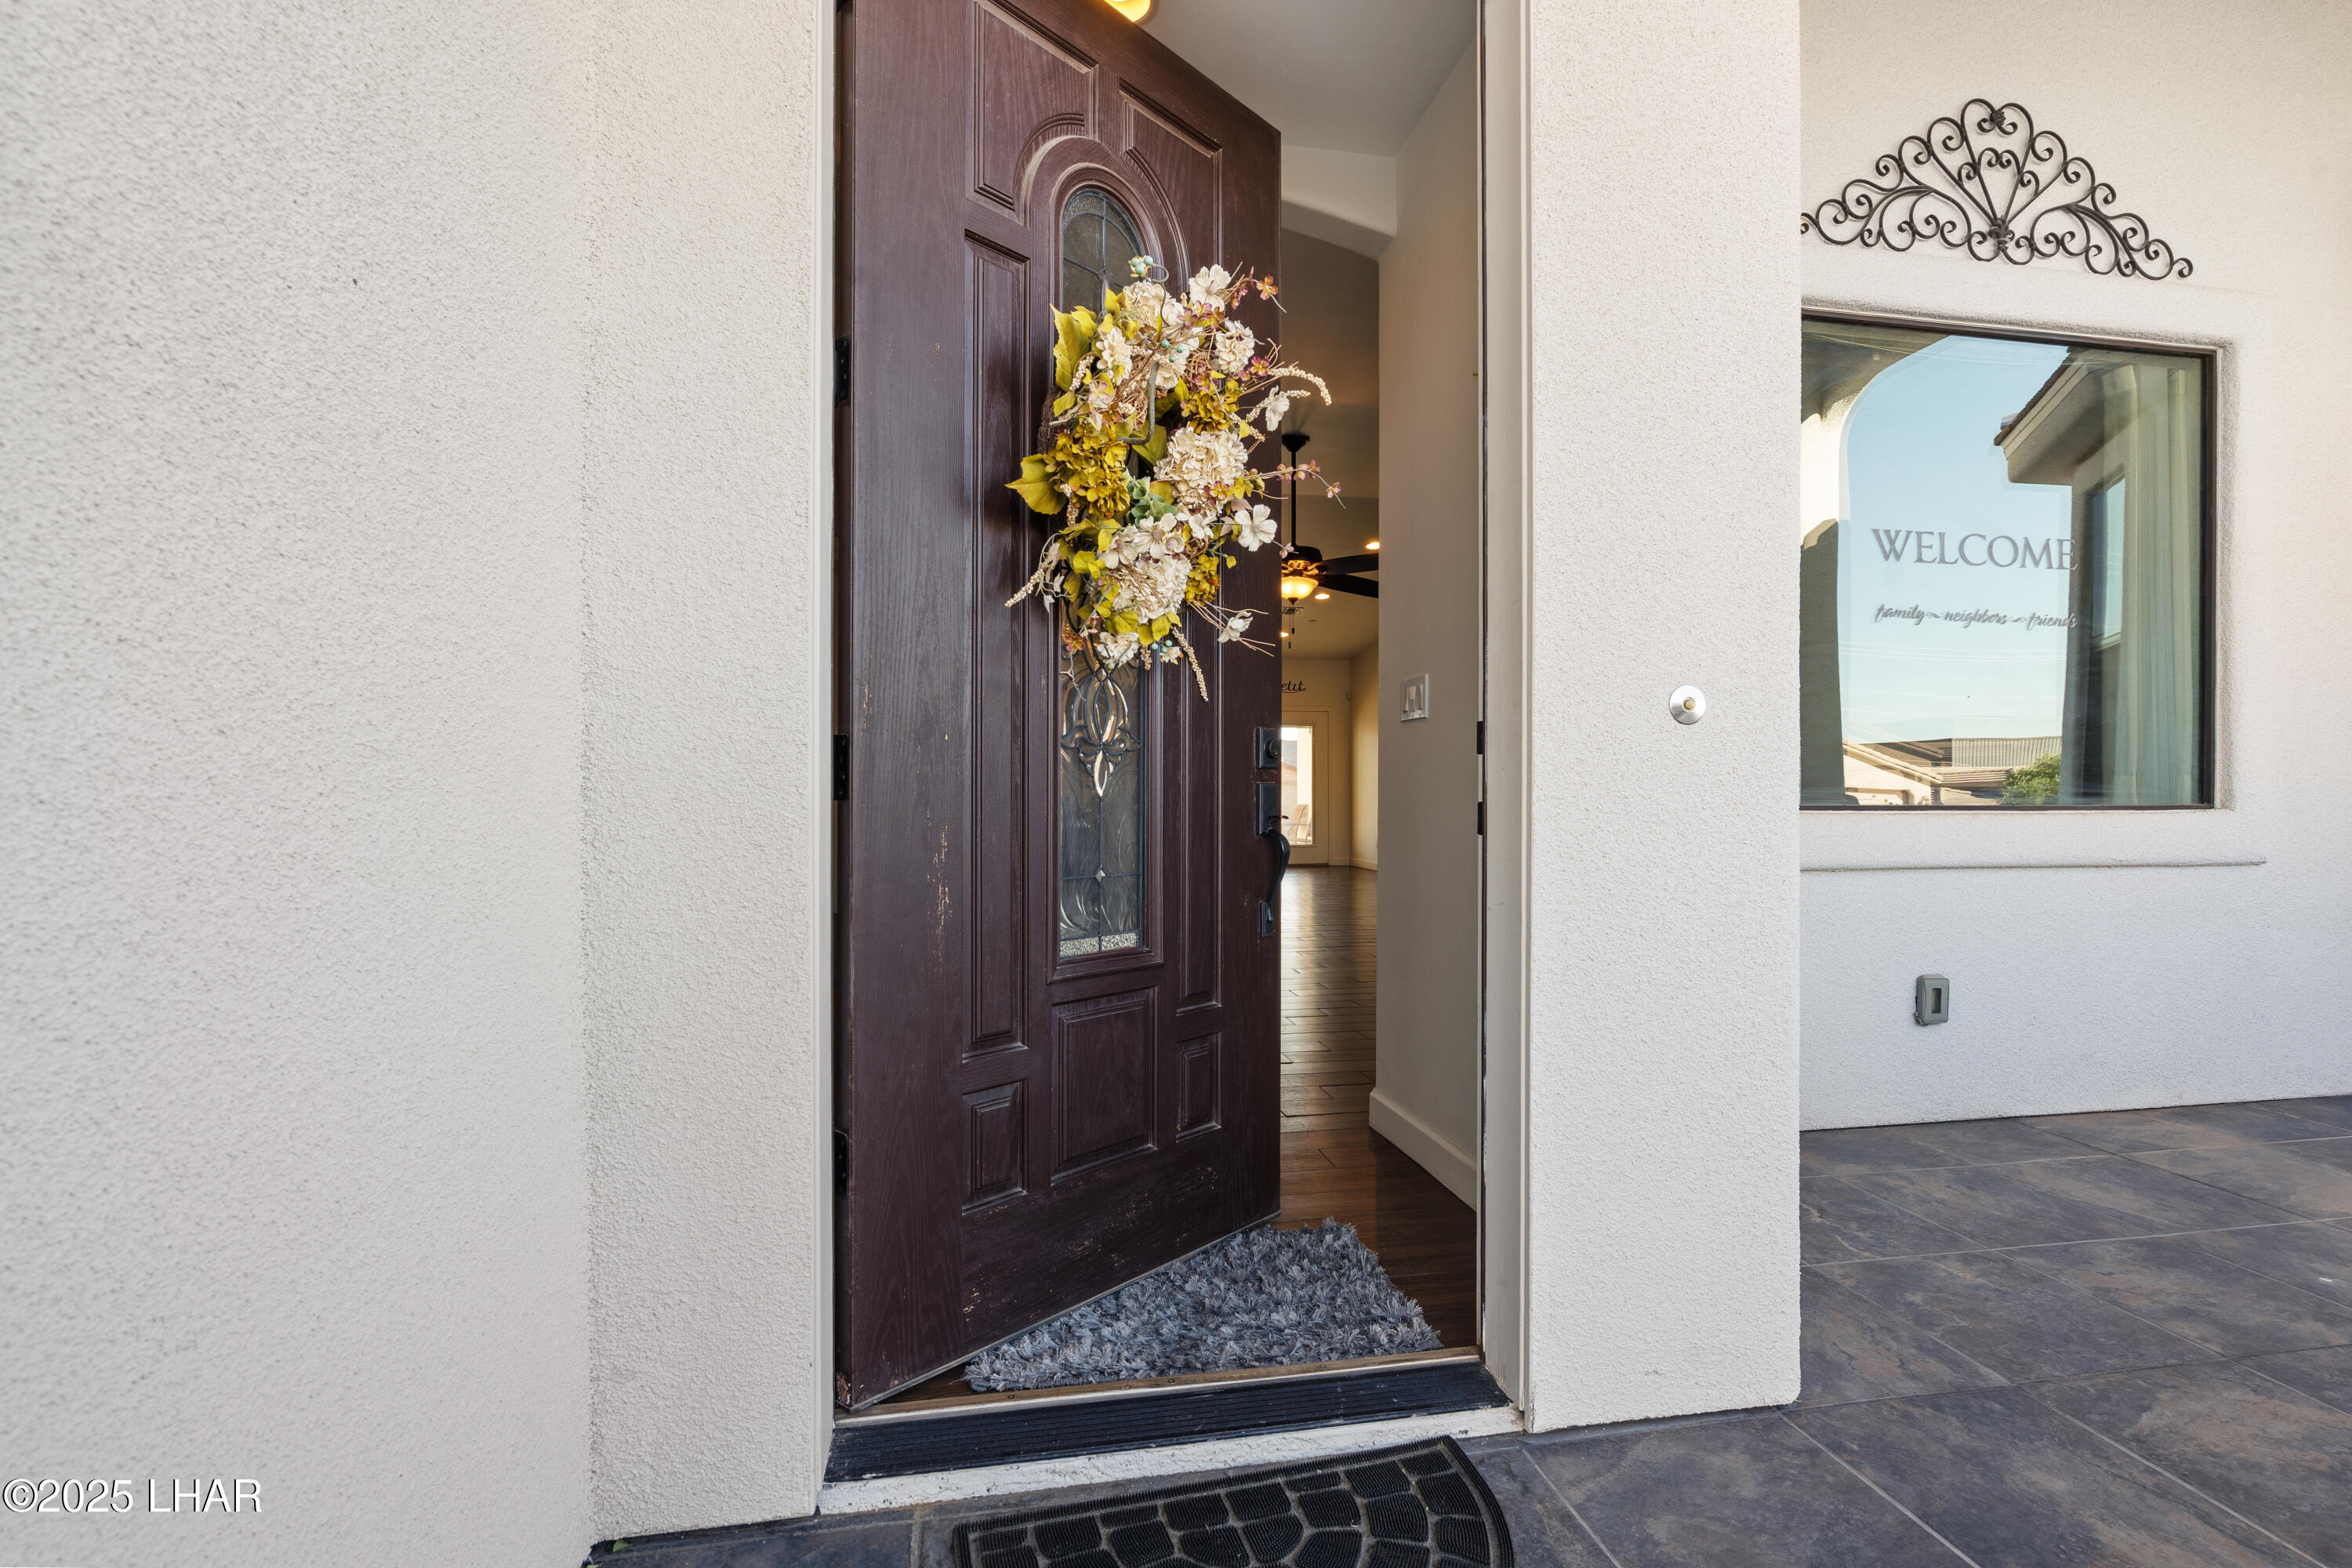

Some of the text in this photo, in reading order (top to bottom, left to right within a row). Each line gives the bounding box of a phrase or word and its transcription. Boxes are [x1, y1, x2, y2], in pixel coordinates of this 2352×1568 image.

[1871, 528, 2078, 571] WELCOME
[1875, 604, 2078, 631] family neighbors friends
